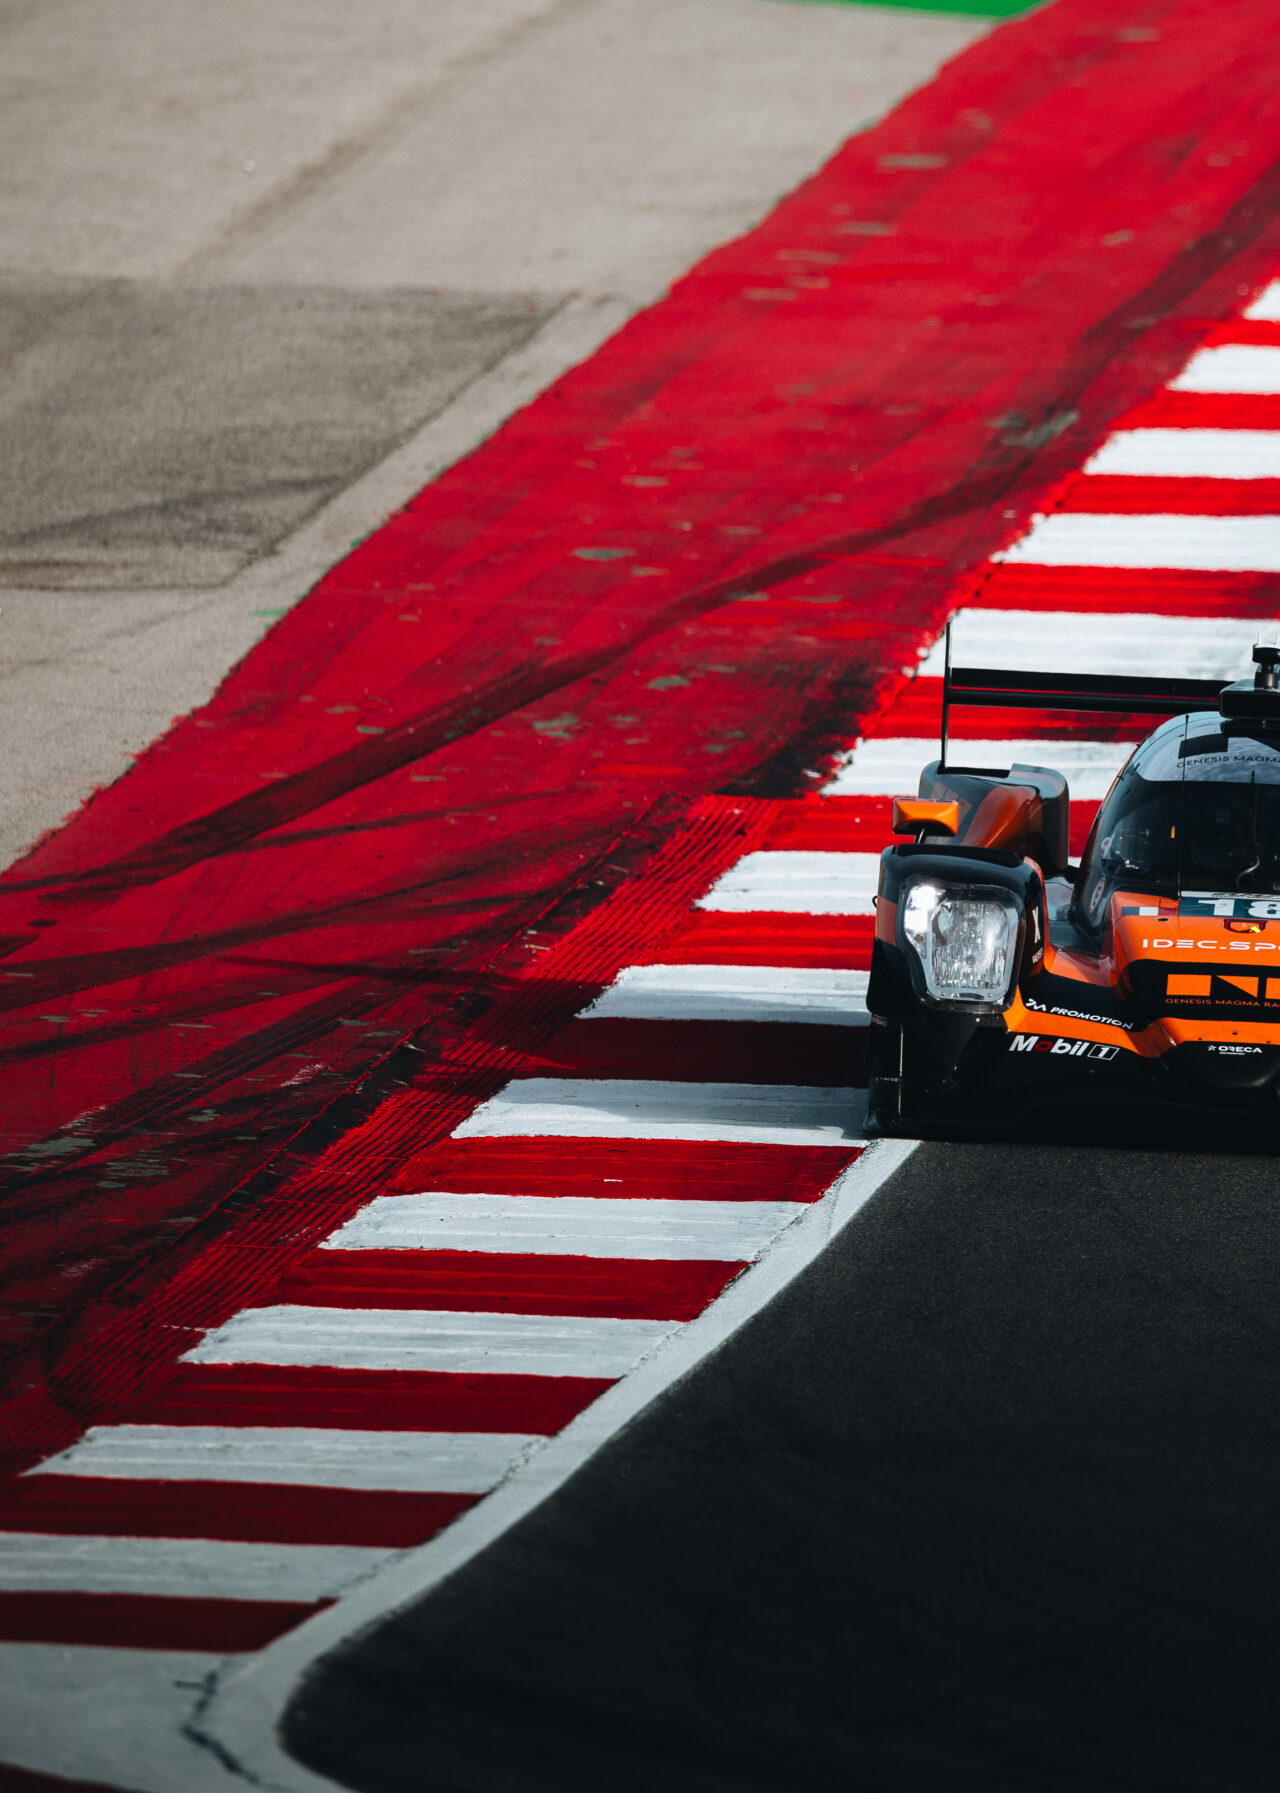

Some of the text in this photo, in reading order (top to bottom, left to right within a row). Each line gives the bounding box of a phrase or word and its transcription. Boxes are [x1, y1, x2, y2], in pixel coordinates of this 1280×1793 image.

[1176, 755, 1230, 768] GENESIS
[1215, 999, 1260, 1007] MAGMA
[1050, 1006, 1134, 1030] PROMOTION
[1009, 1035, 1090, 1056] Mobil
[1218, 1045, 1263, 1054] ORECA
